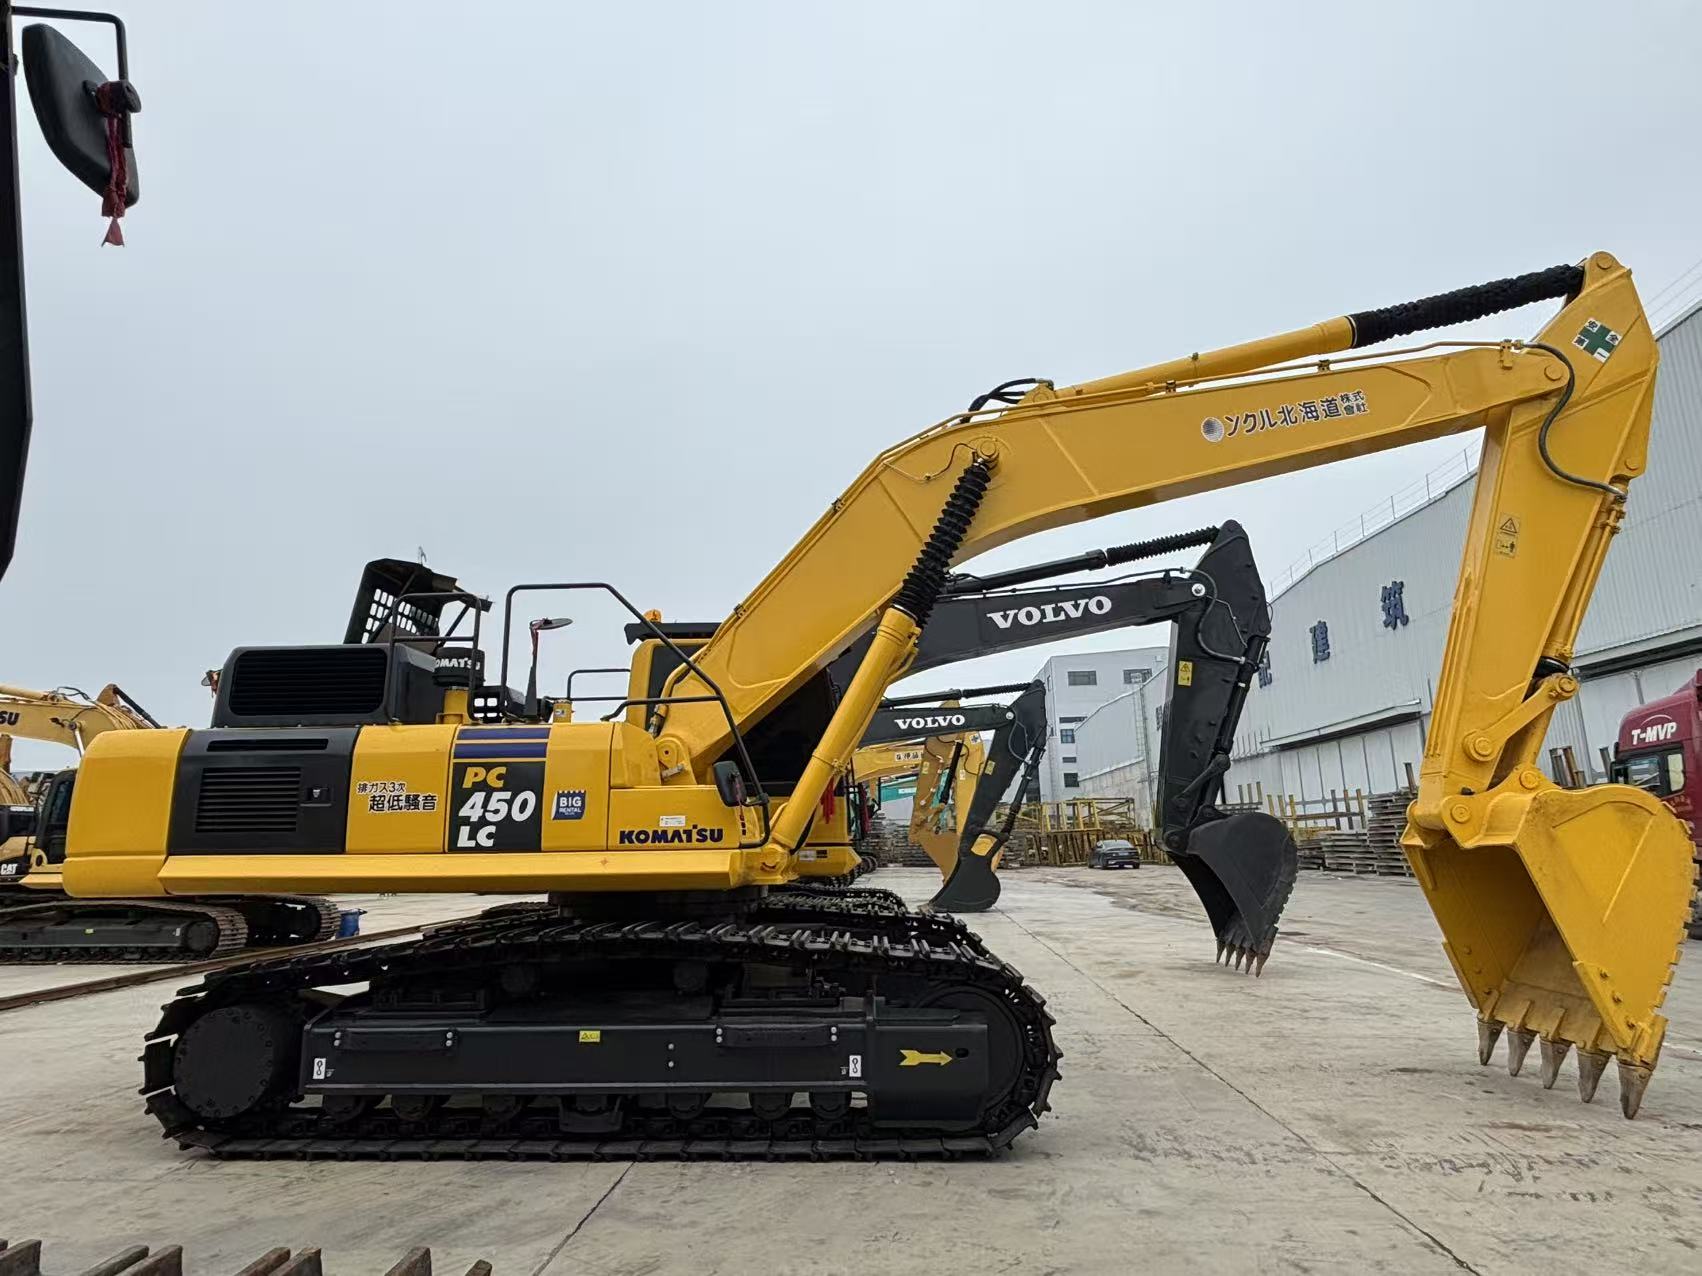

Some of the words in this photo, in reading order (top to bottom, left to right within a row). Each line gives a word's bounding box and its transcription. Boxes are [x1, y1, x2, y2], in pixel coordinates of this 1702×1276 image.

[986, 595, 1112, 629] VOLVO
[434, 657, 481, 671] OMATSU
[894, 714, 966, 730] VOLVO
[1631, 722, 1678, 746] T-MVP
[462, 766, 507, 789] PC
[368, 794, 437, 812] 超低騒音
[458, 790, 537, 822] 450
[559, 796, 582, 807] BIG
[457, 825, 496, 848] LC
[619, 824, 723, 845] KOMATSU
[0, 863, 18, 876] CAT
